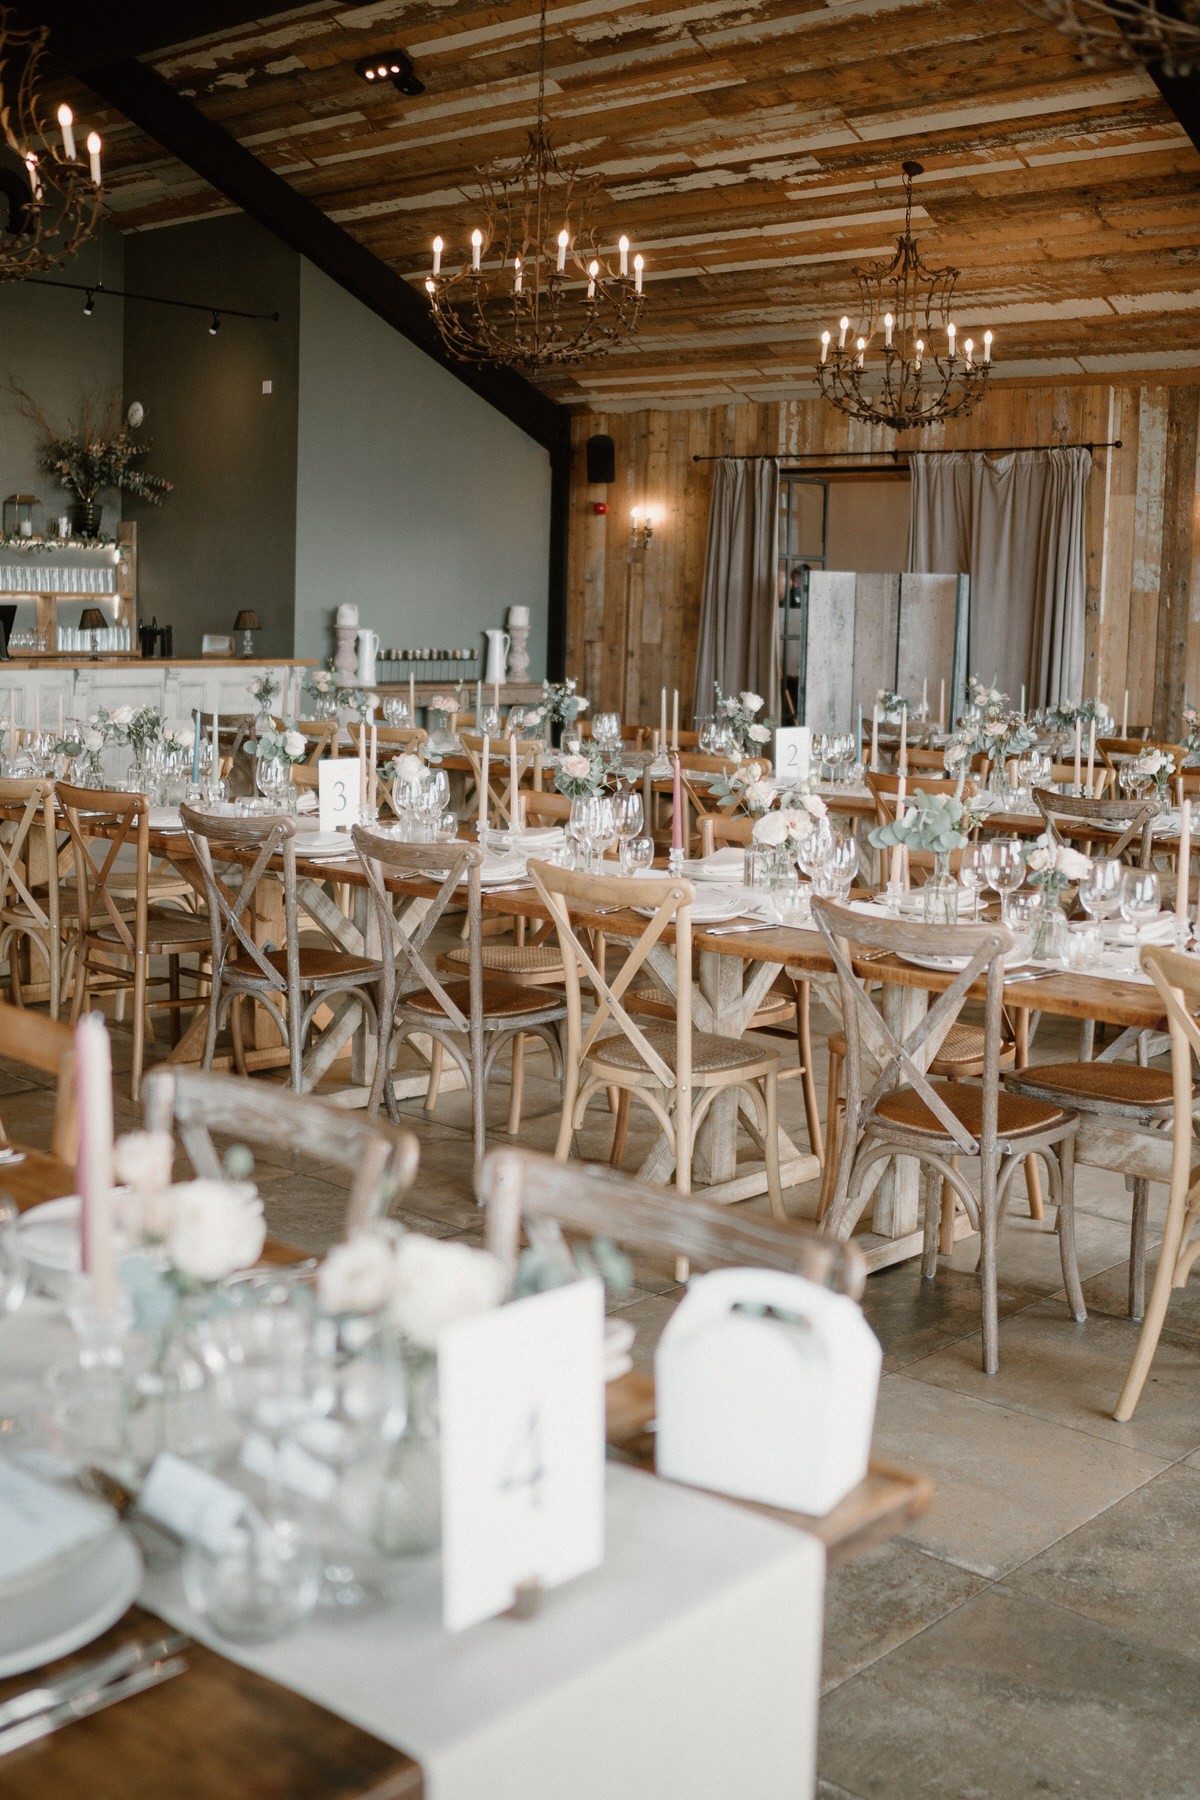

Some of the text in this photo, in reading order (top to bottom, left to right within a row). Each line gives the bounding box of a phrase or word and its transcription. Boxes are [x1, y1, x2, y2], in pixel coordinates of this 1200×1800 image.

[787, 743, 798, 766] 2
[333, 781, 347, 811] 3
[498, 1405, 545, 1511] 4
